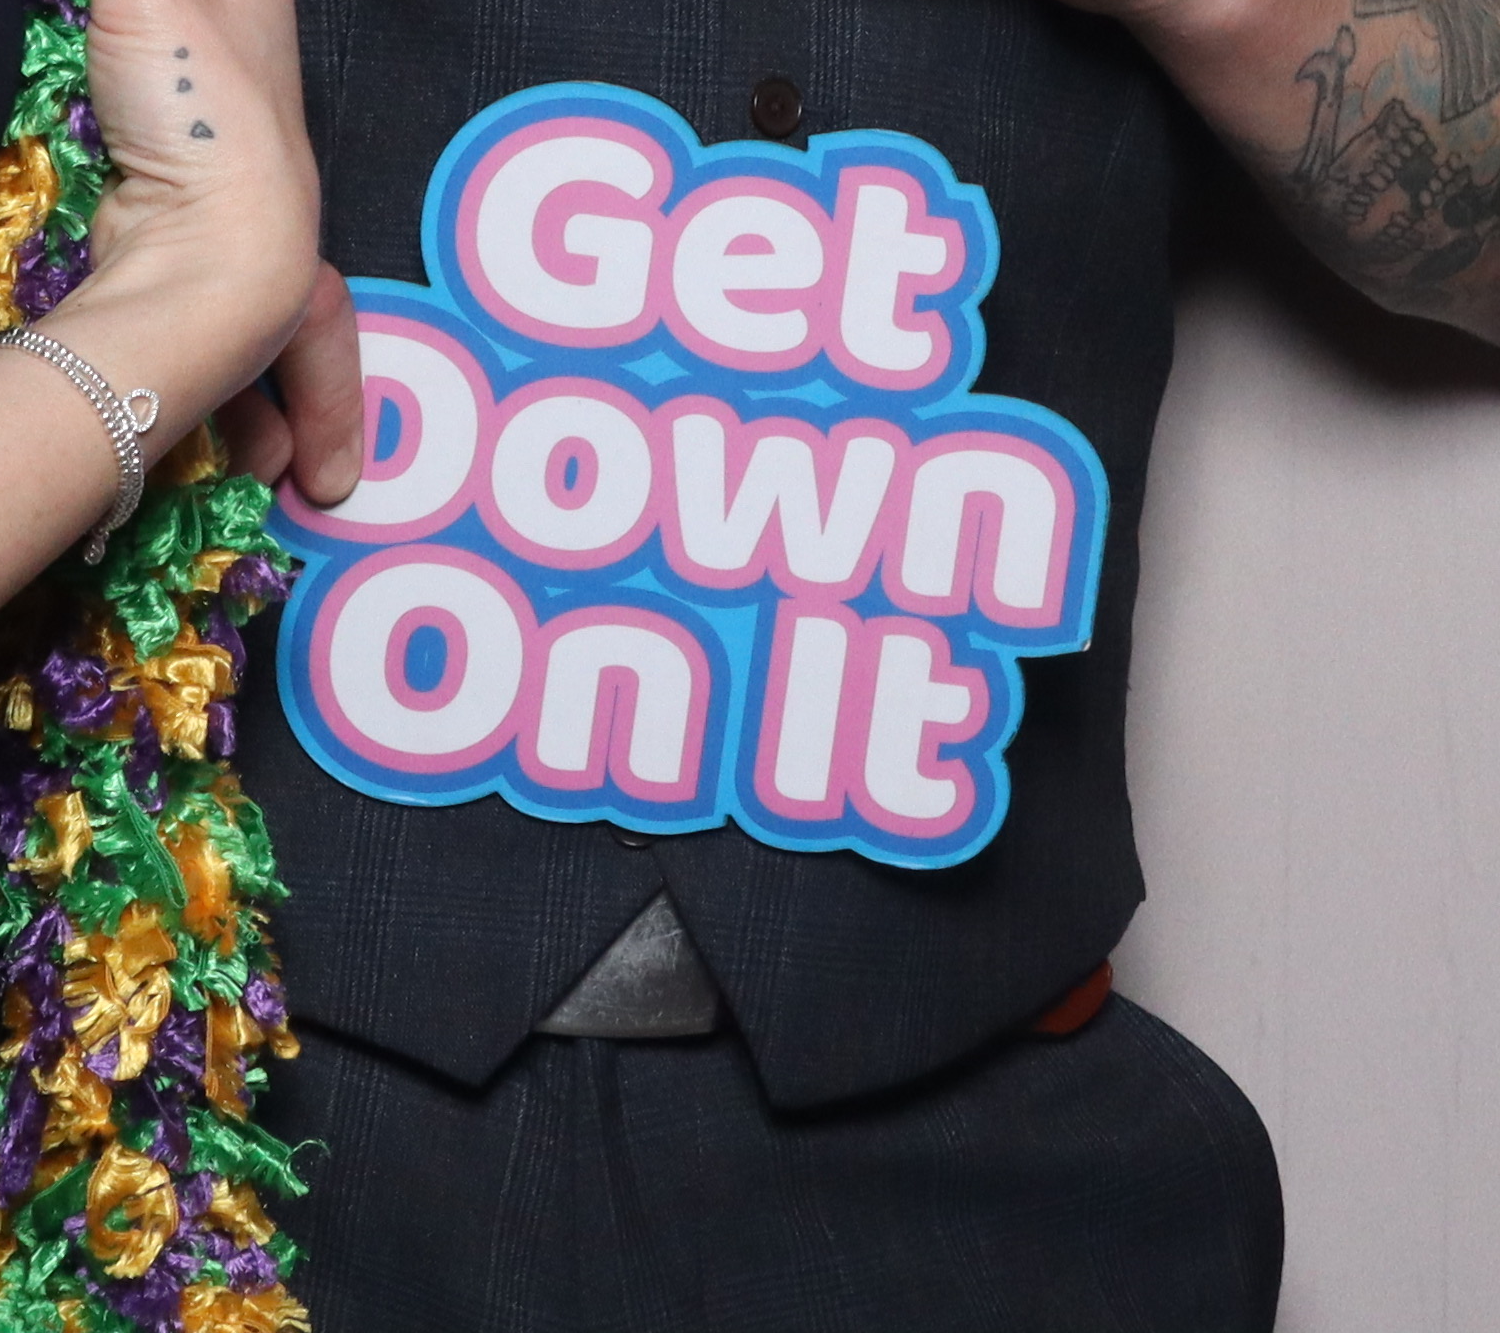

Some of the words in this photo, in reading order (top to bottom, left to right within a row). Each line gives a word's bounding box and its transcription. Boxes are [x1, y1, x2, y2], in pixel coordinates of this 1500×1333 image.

[476, 136, 948, 371] Get
[326, 331, 1057, 609] Down
[329, 562, 693, 783] On
[773, 616, 971, 819] It
